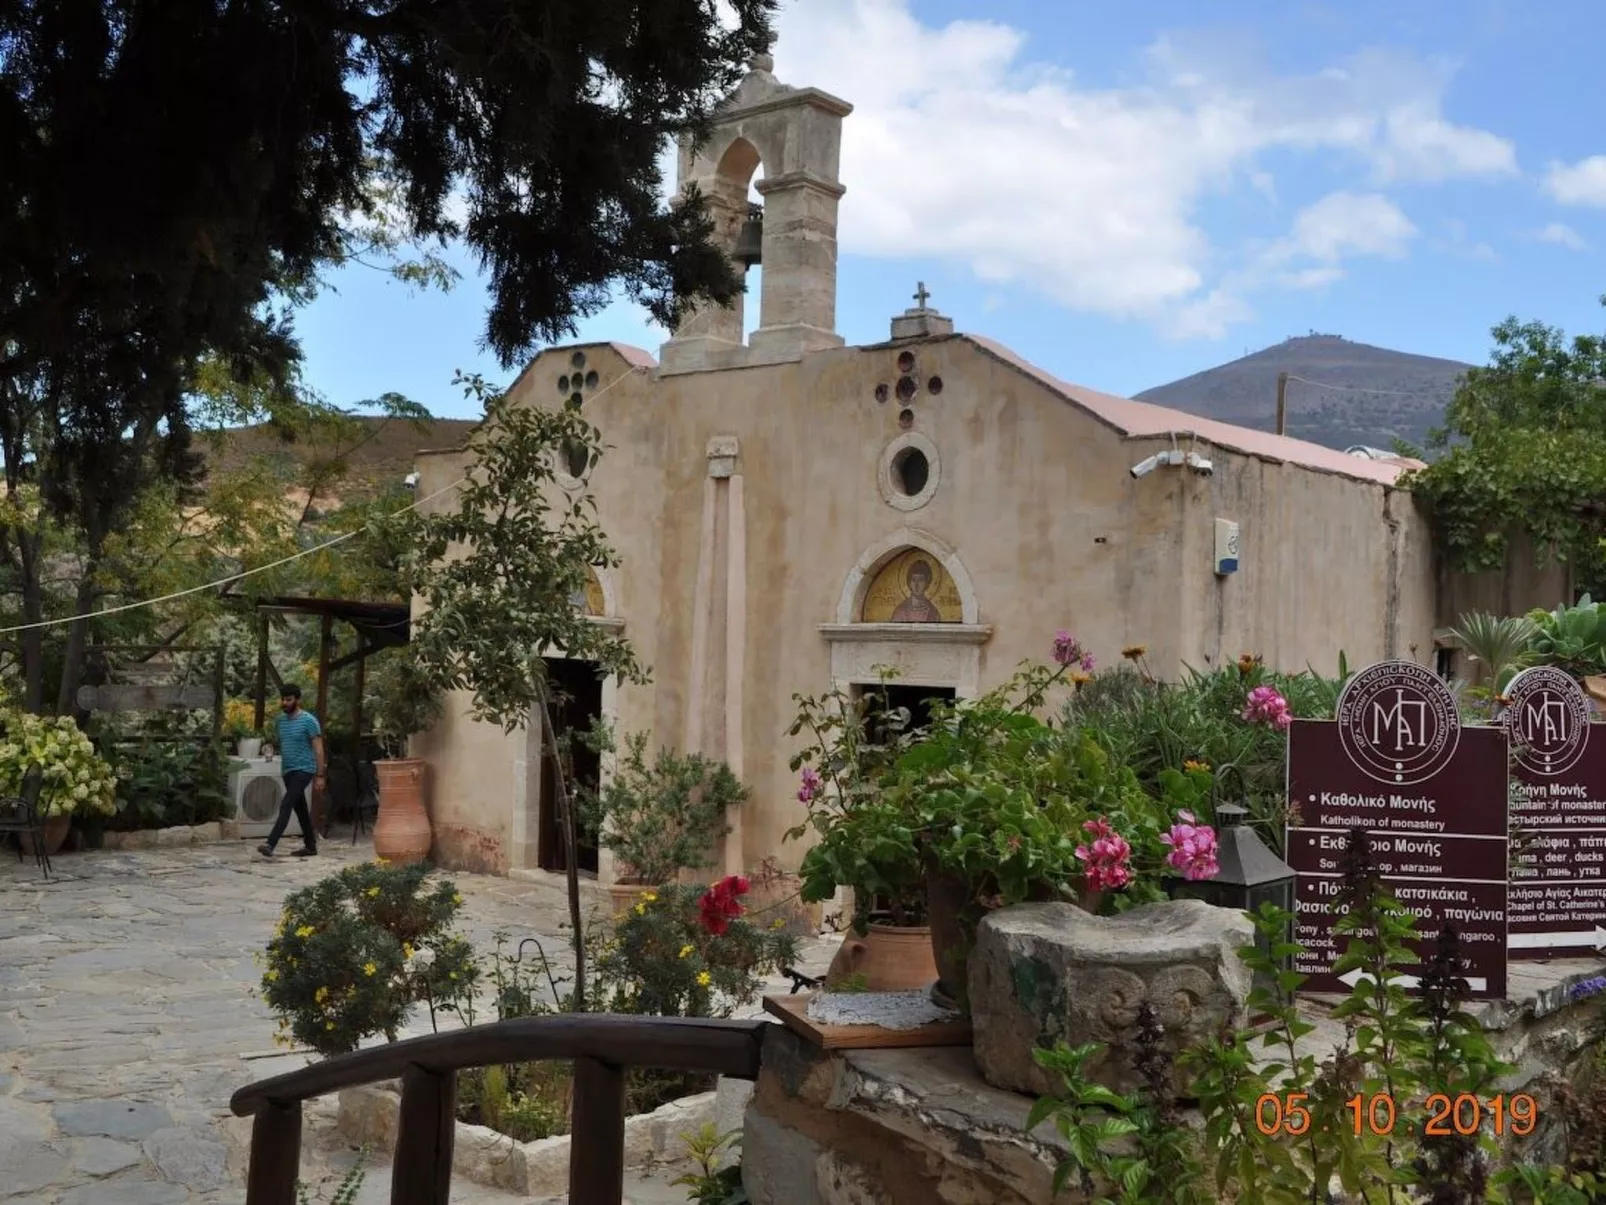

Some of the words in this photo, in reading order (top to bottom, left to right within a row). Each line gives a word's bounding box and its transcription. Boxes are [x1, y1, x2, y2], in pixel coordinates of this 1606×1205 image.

[1549, 783, 1587, 798] Μονής
[1320, 791, 1386, 808] Καθολικό
[1390, 795, 1436, 813] Μονής
[1561, 801, 1606, 810] monaster
[1320, 814, 1376, 827] Katholikon
[1378, 817, 1389, 827] of
[1391, 819, 1445, 832] monastery
[1564, 815, 1606, 824] источни
[1395, 839, 1442, 857] Μονής
[1545, 852, 1567, 862] deer
[1574, 851, 1604, 861] ducks
[1400, 863, 1442, 873] магазин
[1579, 867, 1601, 878] утка
[1395, 886, 1468, 901] κατσικάκια
[1545, 888, 1571, 900] Αγίας
[1536, 901, 1545, 909] of
[1444, 906, 1504, 923] παγώνια
[1459, 931, 1495, 943] ngaroo
